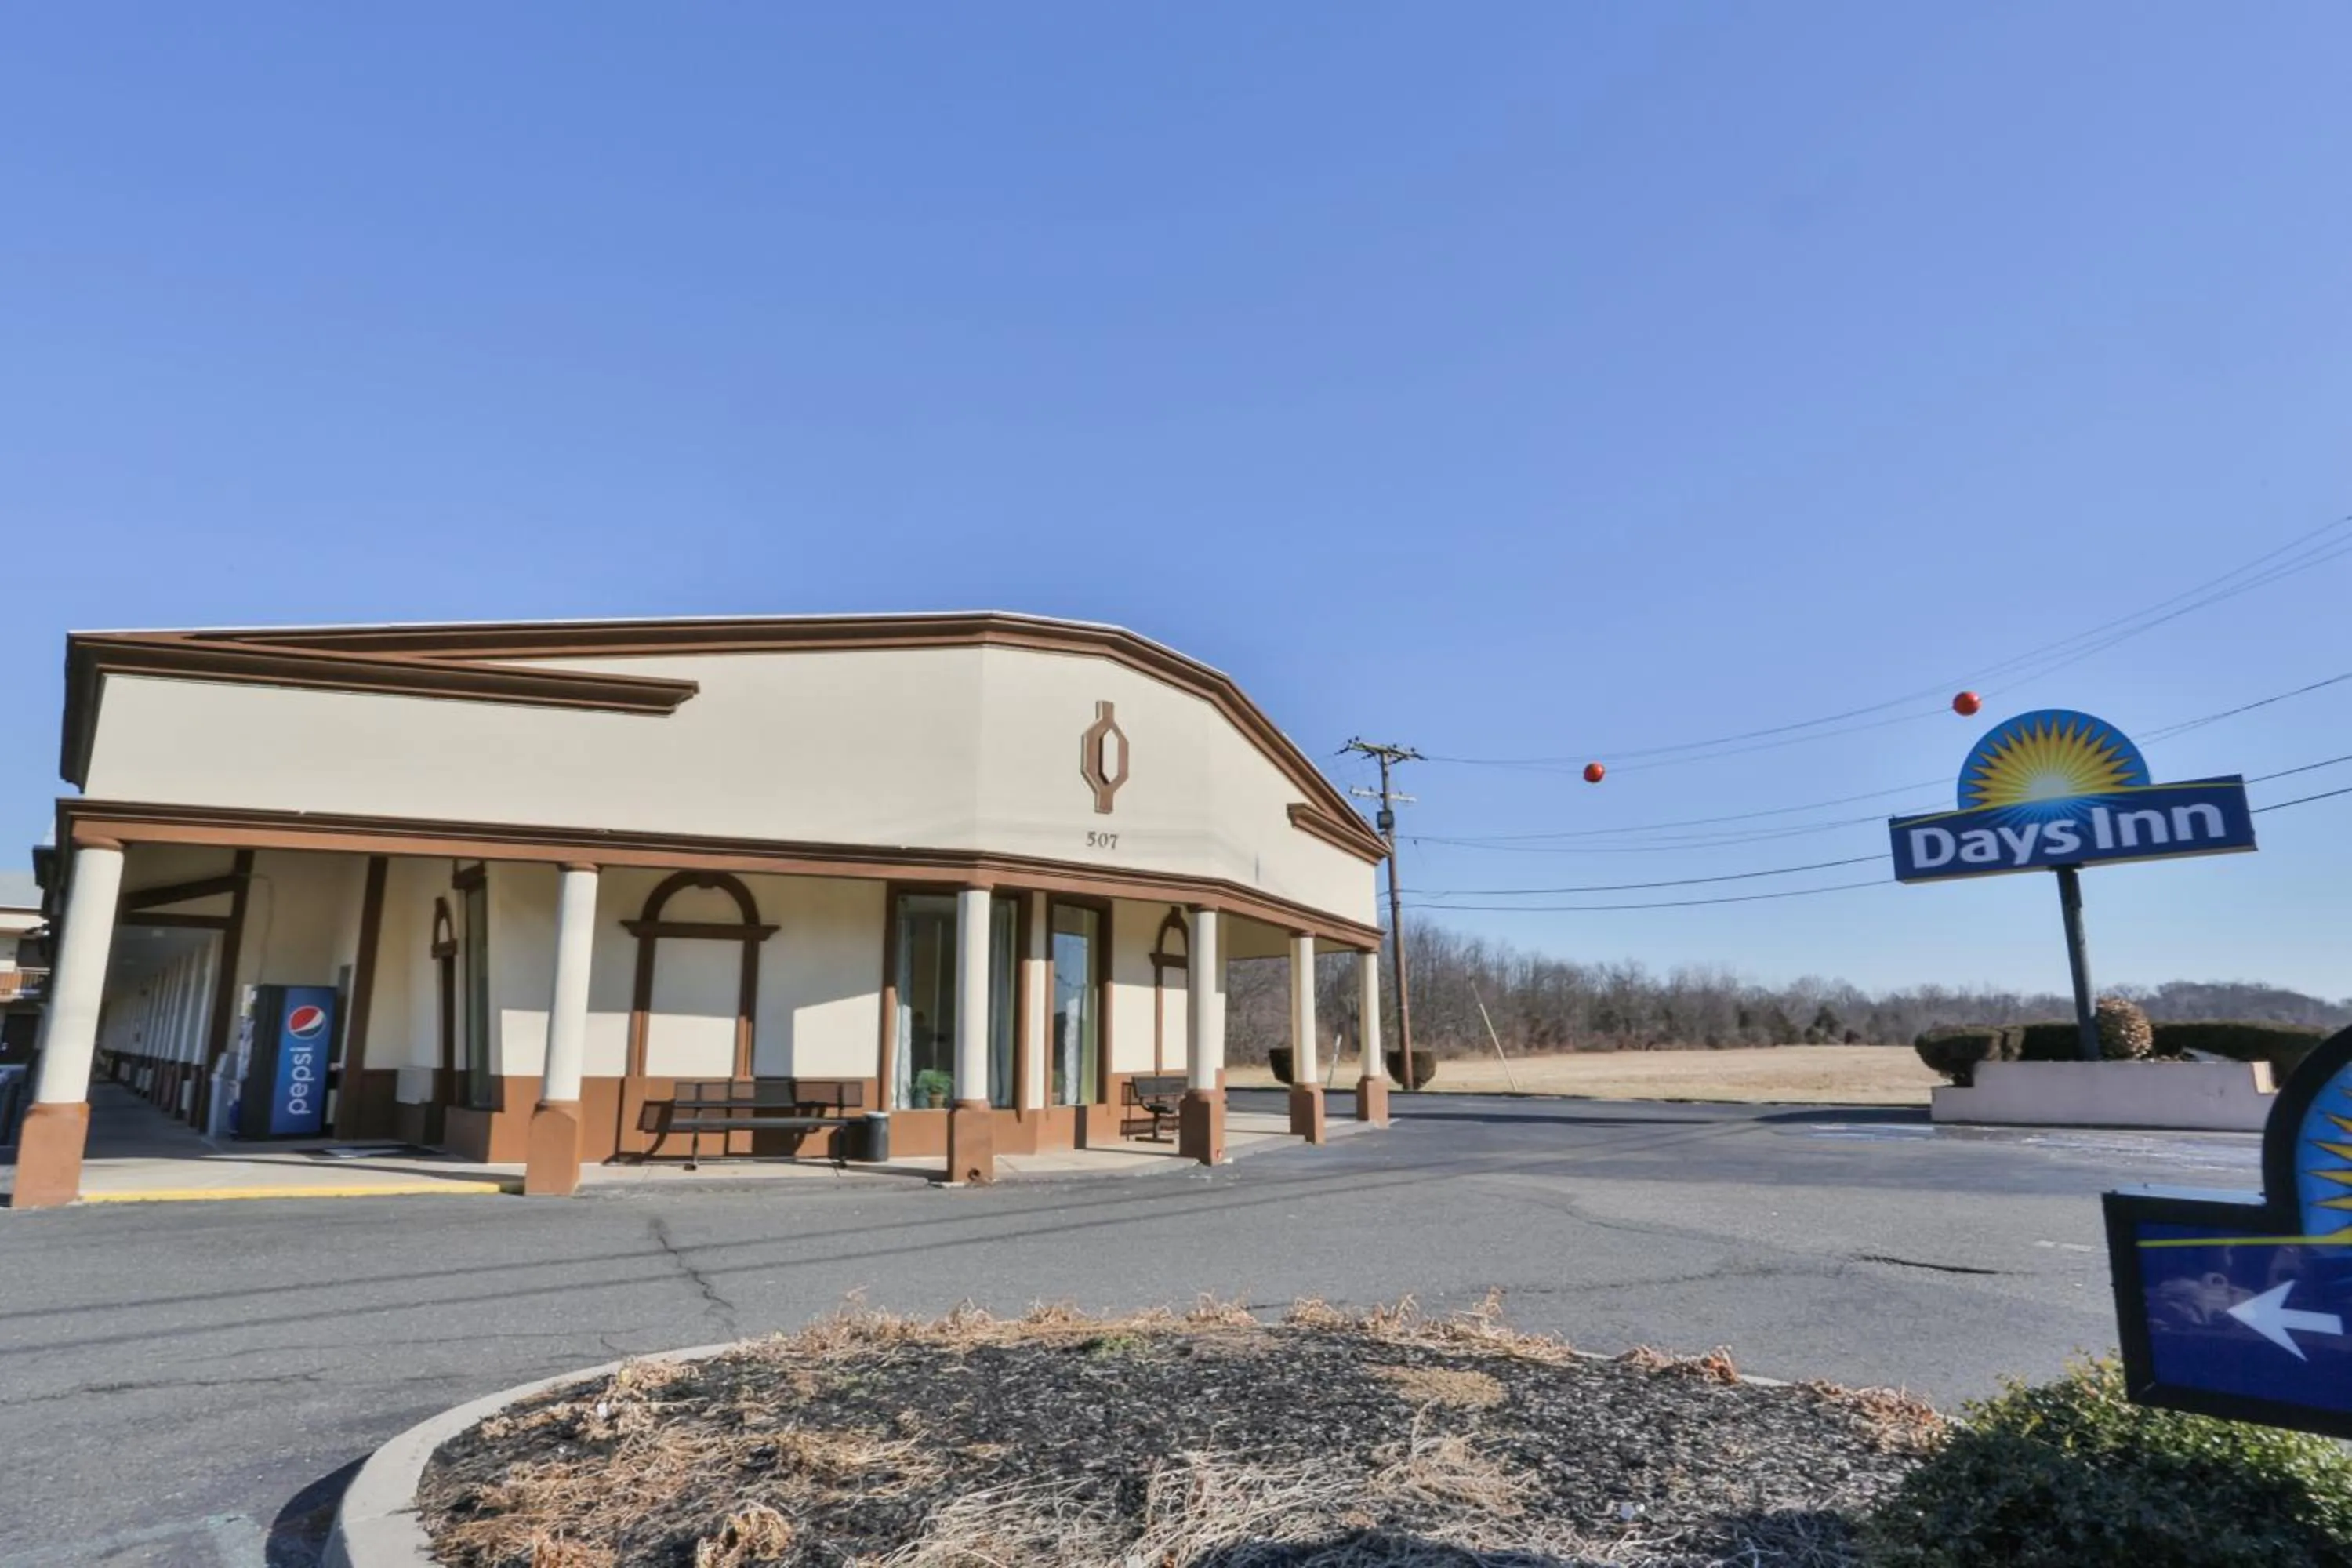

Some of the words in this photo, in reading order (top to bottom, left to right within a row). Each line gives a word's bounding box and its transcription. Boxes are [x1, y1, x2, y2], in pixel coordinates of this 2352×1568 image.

[1086, 831, 1119, 850] 507
[1909, 818, 2081, 869] Days
[2092, 800, 2227, 850] Inn
[288, 1047, 314, 1116] pepsi
